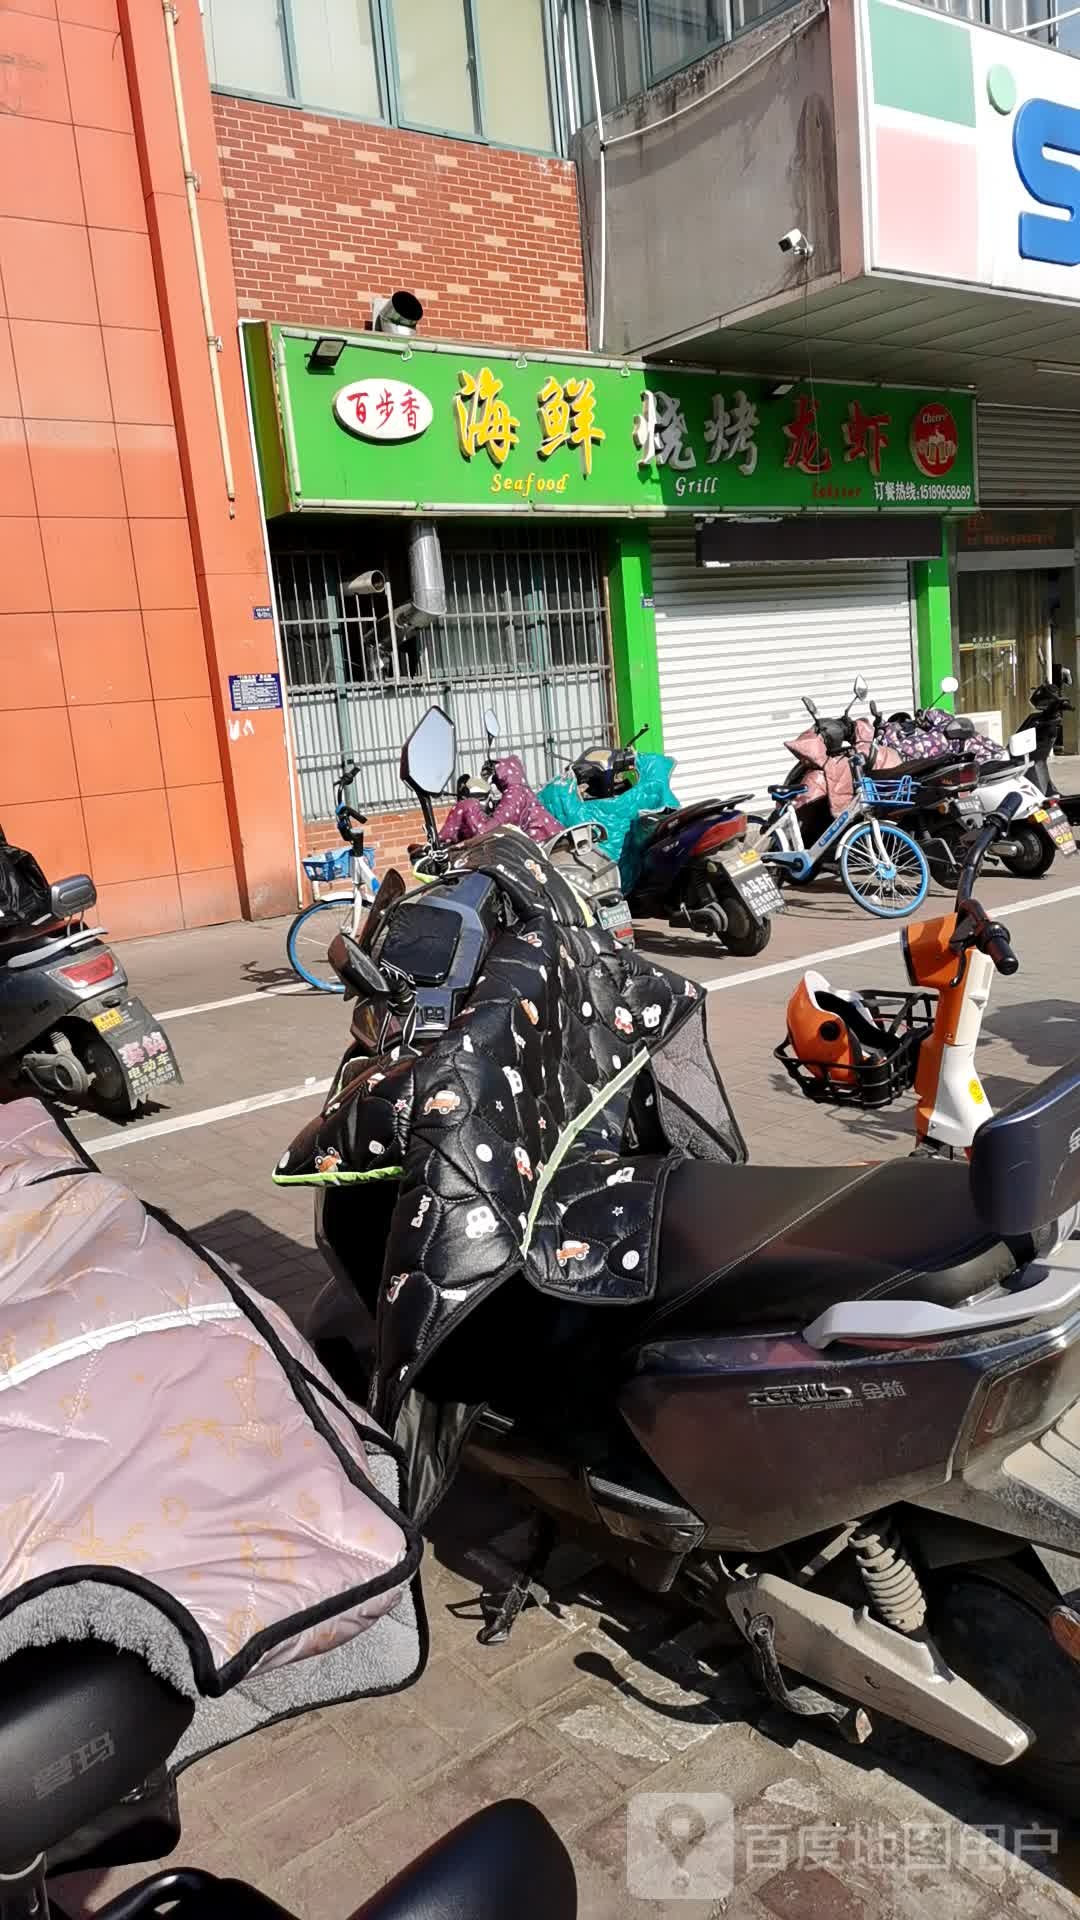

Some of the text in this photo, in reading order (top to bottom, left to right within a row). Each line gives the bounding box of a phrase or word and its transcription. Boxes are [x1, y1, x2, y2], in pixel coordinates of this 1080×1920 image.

[346, 388, 421, 432] 百步香
[490, 473, 570, 497] Seafood
[675, 476, 719, 497] Grill
